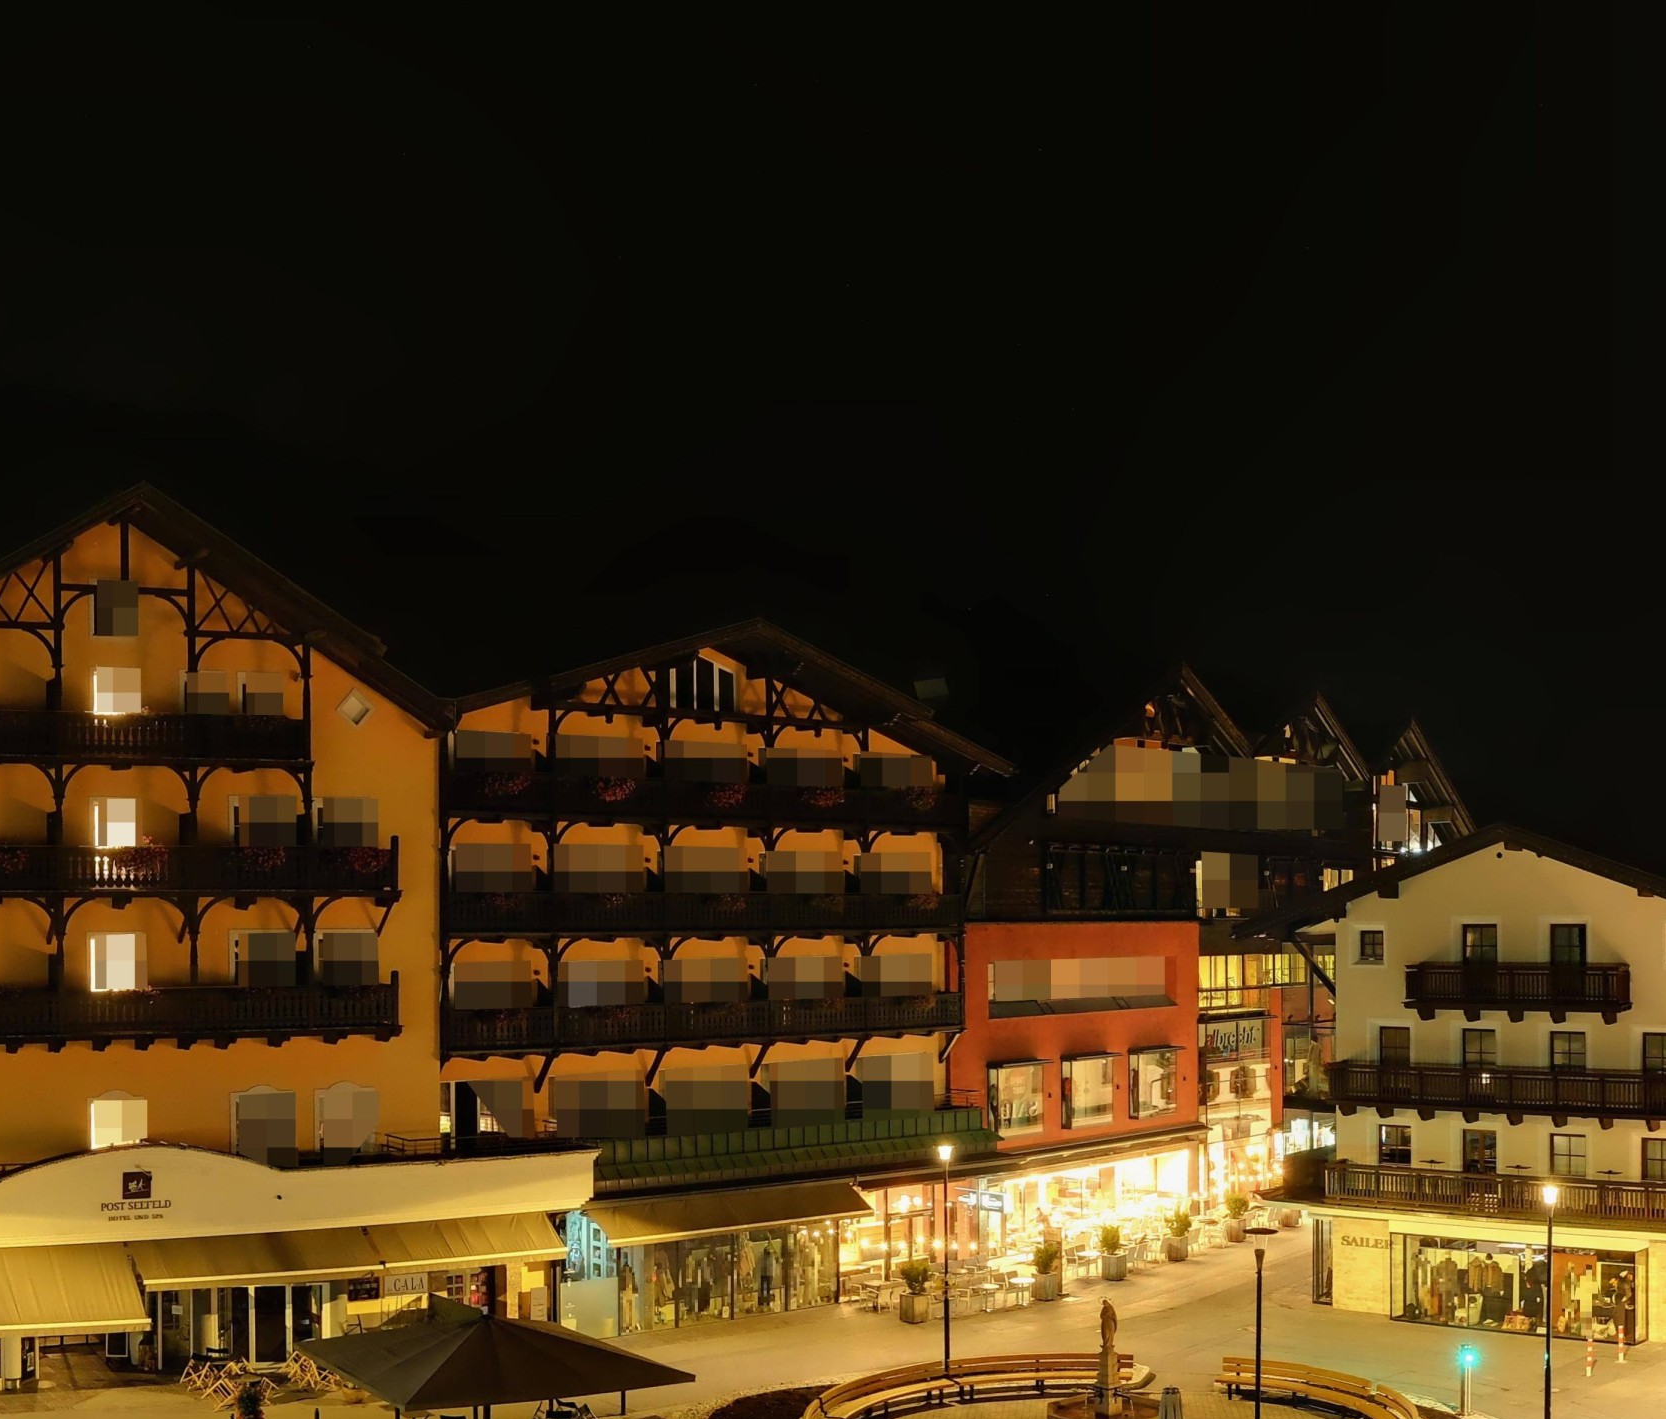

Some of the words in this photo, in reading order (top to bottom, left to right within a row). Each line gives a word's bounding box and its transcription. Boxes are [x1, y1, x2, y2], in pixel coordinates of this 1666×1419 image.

[101, 1202, 126, 1212] POST
[128, 1200, 172, 1211] SEEFELD
[393, 1277, 424, 1291] CALA
